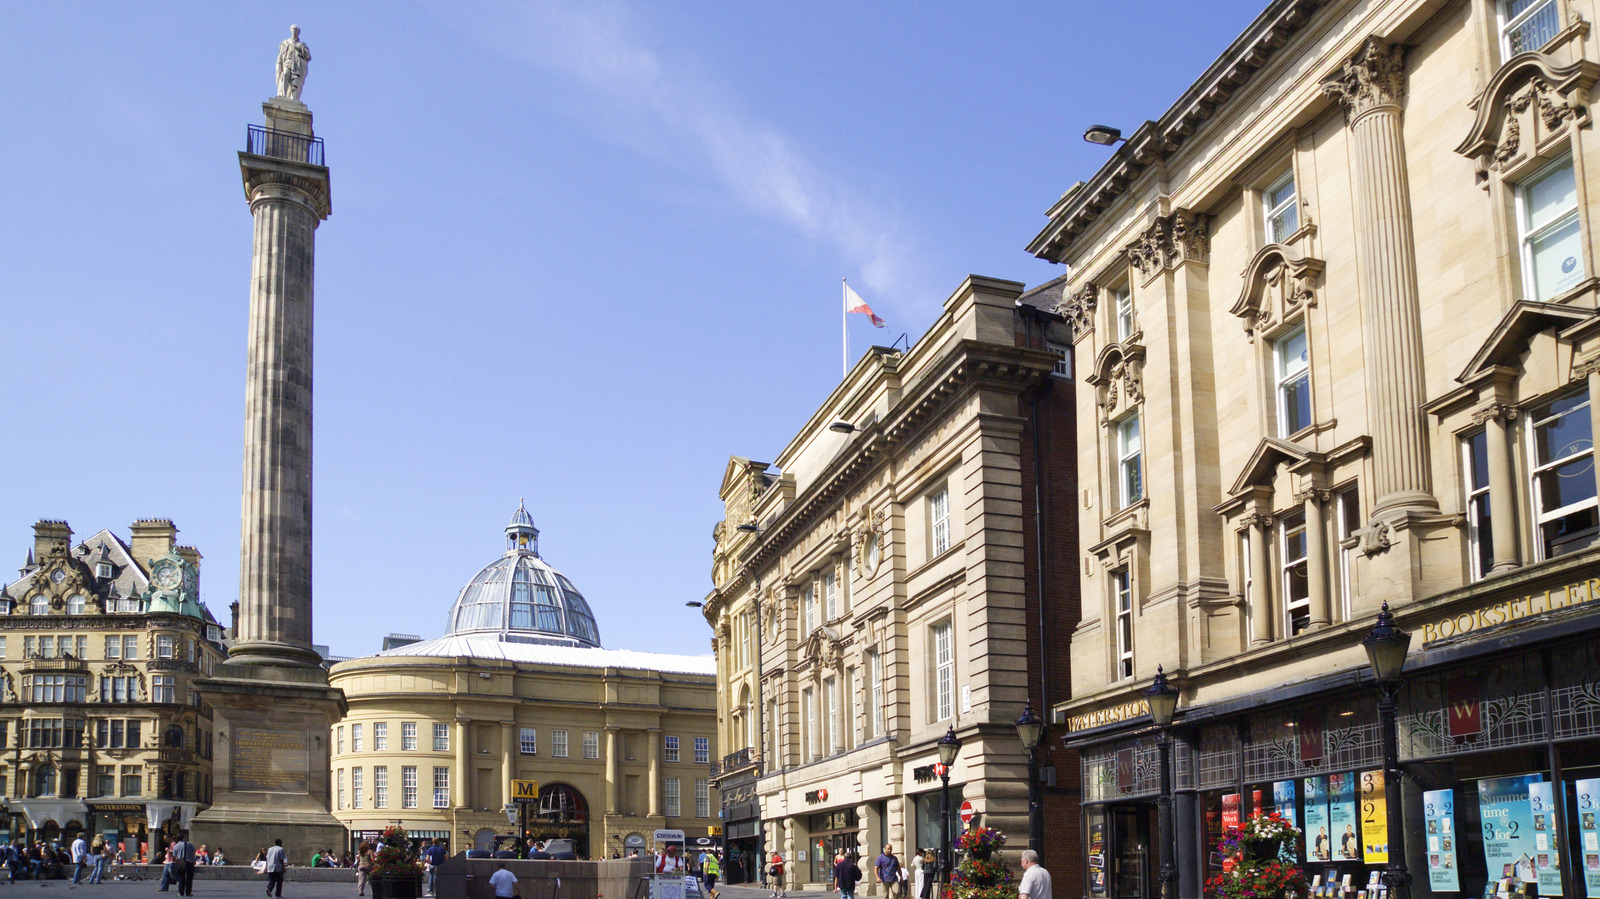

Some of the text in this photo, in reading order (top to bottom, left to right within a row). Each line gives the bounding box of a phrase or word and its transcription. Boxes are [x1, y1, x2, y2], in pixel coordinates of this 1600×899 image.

[1569, 443, 1579, 453] W
[1068, 700, 1150, 732] WATERSTON
[1453, 699, 1475, 719] W
[1303, 728, 1320, 745] W
[518, 782, 533, 795] M
[1306, 777, 1314, 792] 3
[1332, 774, 1340, 790] 3
[1363, 774, 1374, 794] 3
[1275, 791, 1280, 803] 3
[1288, 790, 1293, 800] 2
[1332, 795, 1340, 810] 2
[1482, 792, 1530, 806] Summer
[1533, 796, 1542, 811] 3
[1581, 794, 1591, 809] 3
[1307, 798, 1314, 812] 2
[1427, 801, 1452, 817] 3 for 2
[1483, 807, 1509, 818] time
[1364, 803, 1375, 823] 2
[1484, 821, 1519, 841] 3 for 2
